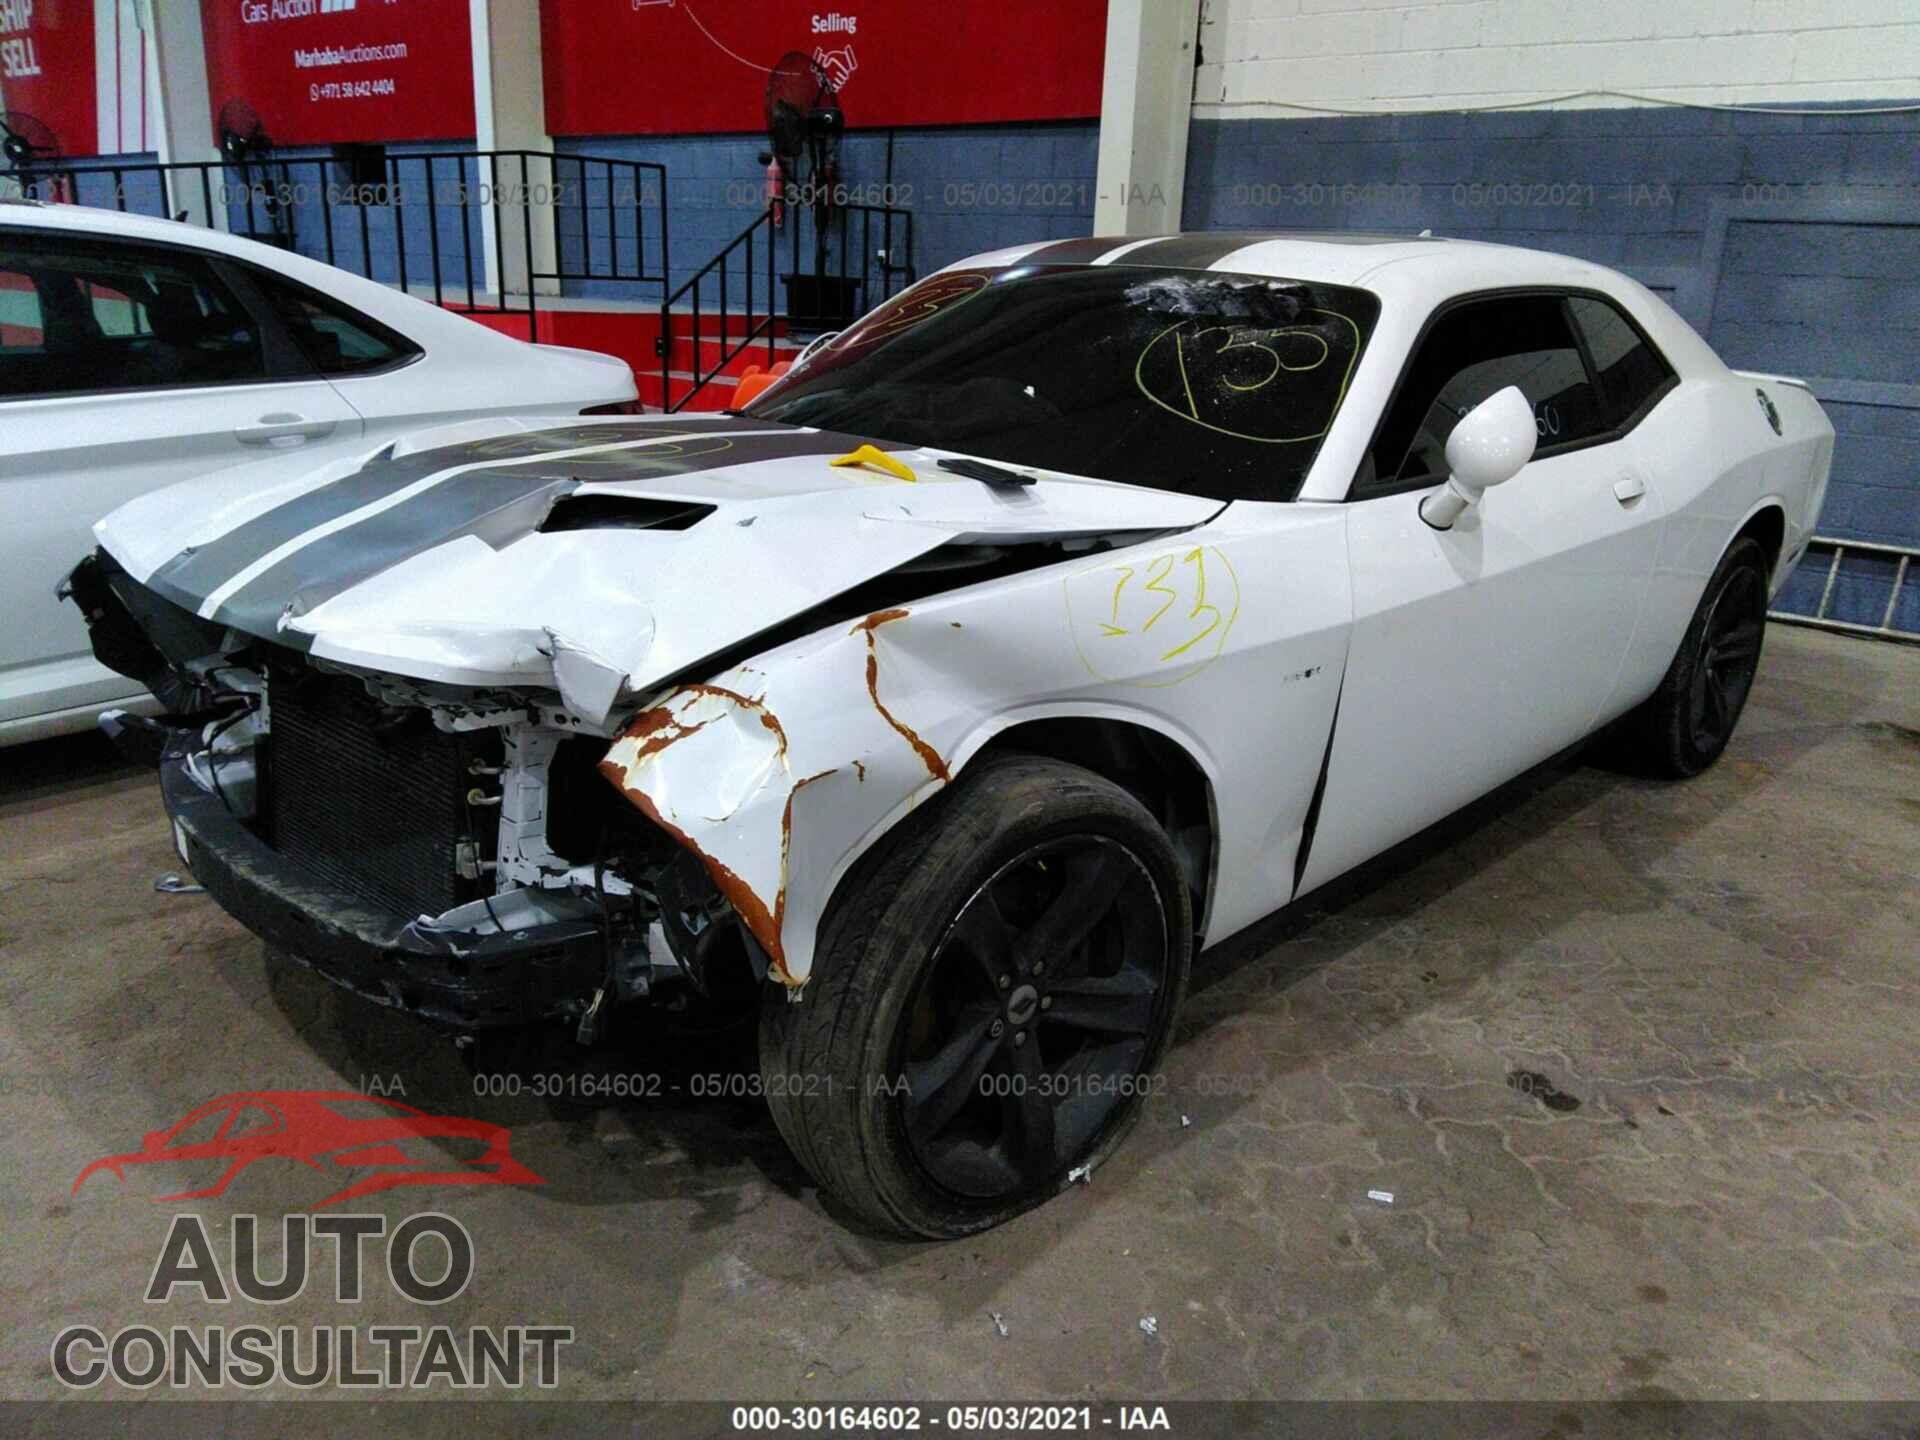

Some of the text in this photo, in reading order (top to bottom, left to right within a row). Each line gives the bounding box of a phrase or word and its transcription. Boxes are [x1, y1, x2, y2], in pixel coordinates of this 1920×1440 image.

[241, 0, 317, 23] Cars Auction
[811, 13, 857, 34] Selling
[1, 36, 42, 77] SELL
[294, 43, 408, 68] MarhabaAuctions.com
[320, 82, 341, 99] +971
